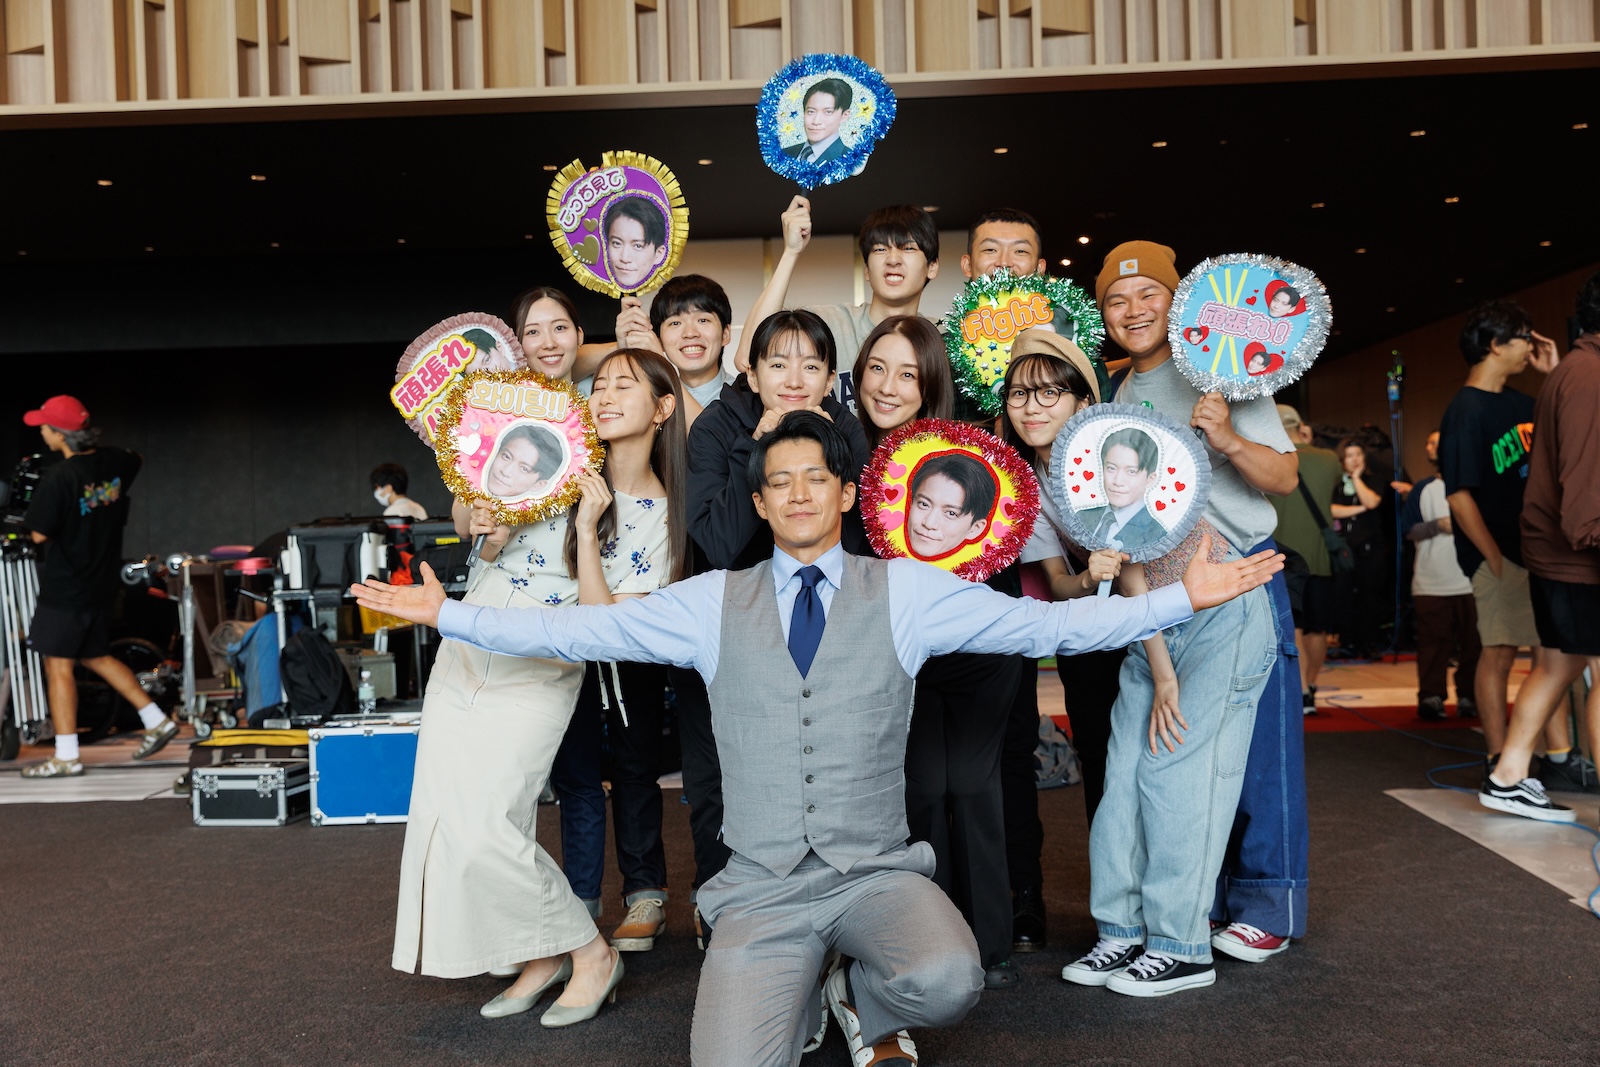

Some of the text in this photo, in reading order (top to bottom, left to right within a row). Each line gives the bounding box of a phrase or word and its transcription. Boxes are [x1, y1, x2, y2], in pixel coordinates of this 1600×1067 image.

[559, 169, 623, 228] こっち見て
[963, 295, 1050, 341] Fight
[395, 338, 471, 413] 頑張れ
[471, 381, 567, 419] 화이팅!!
